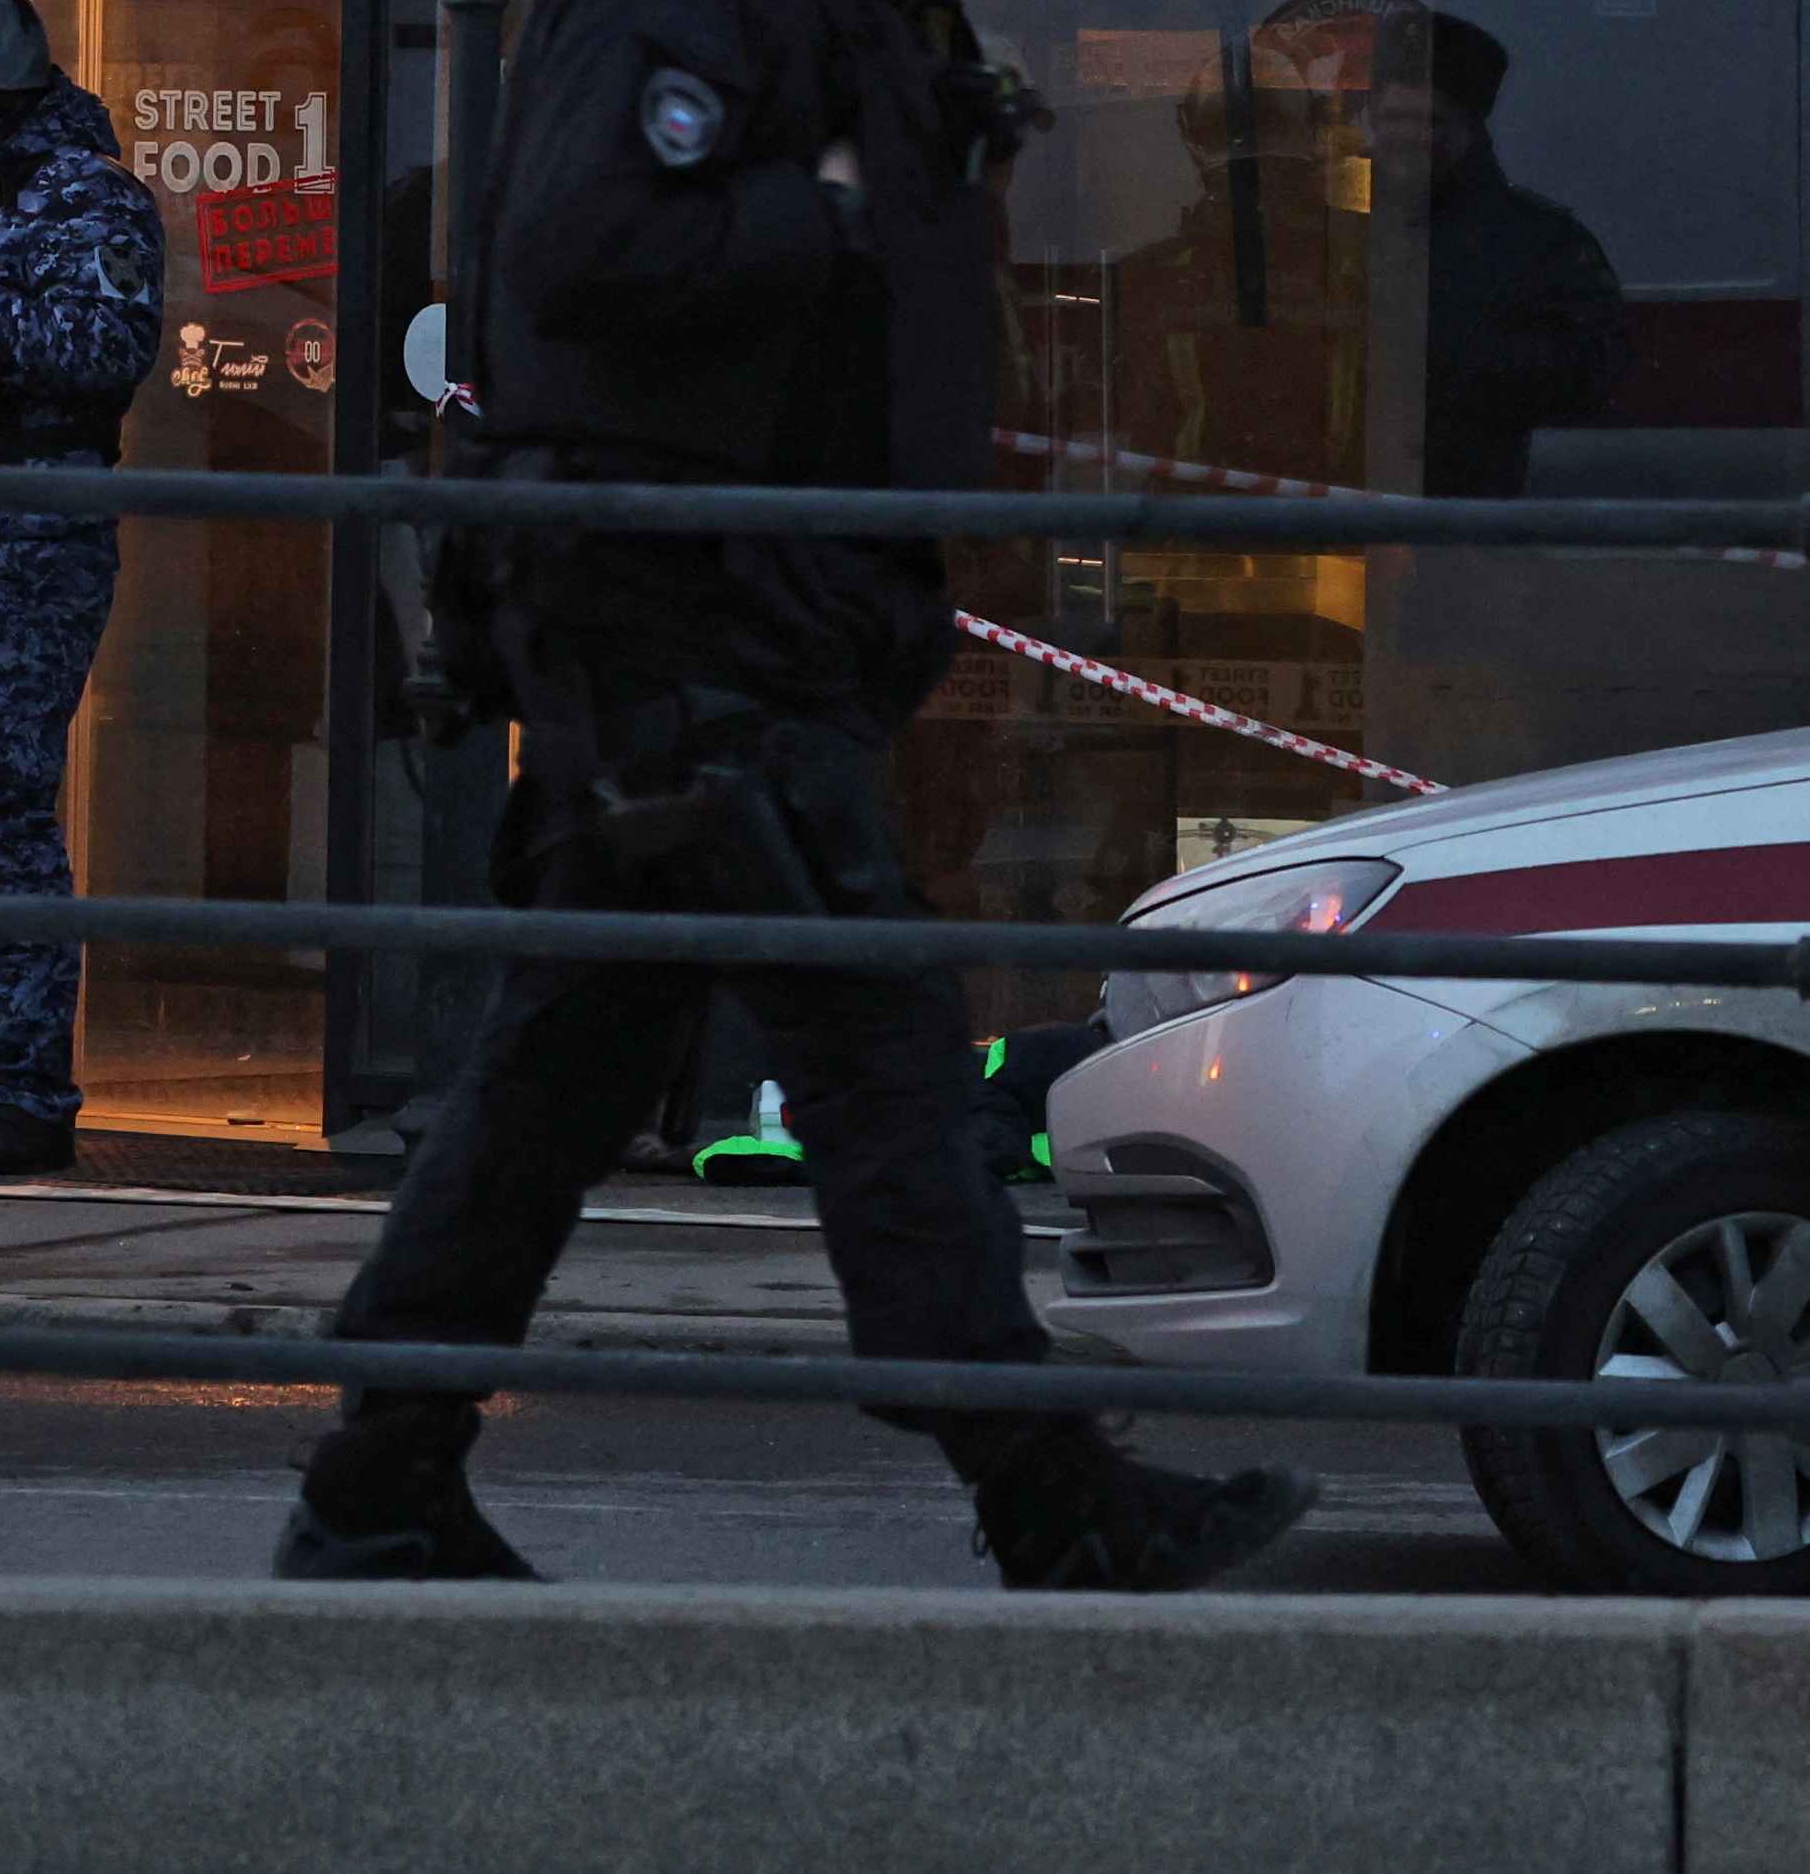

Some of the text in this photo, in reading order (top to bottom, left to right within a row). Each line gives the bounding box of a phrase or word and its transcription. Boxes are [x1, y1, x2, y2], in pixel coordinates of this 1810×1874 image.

[134, 89, 281, 131] STREET
[133, 141, 280, 193] FOOD
[294, 91, 336, 194] 1
